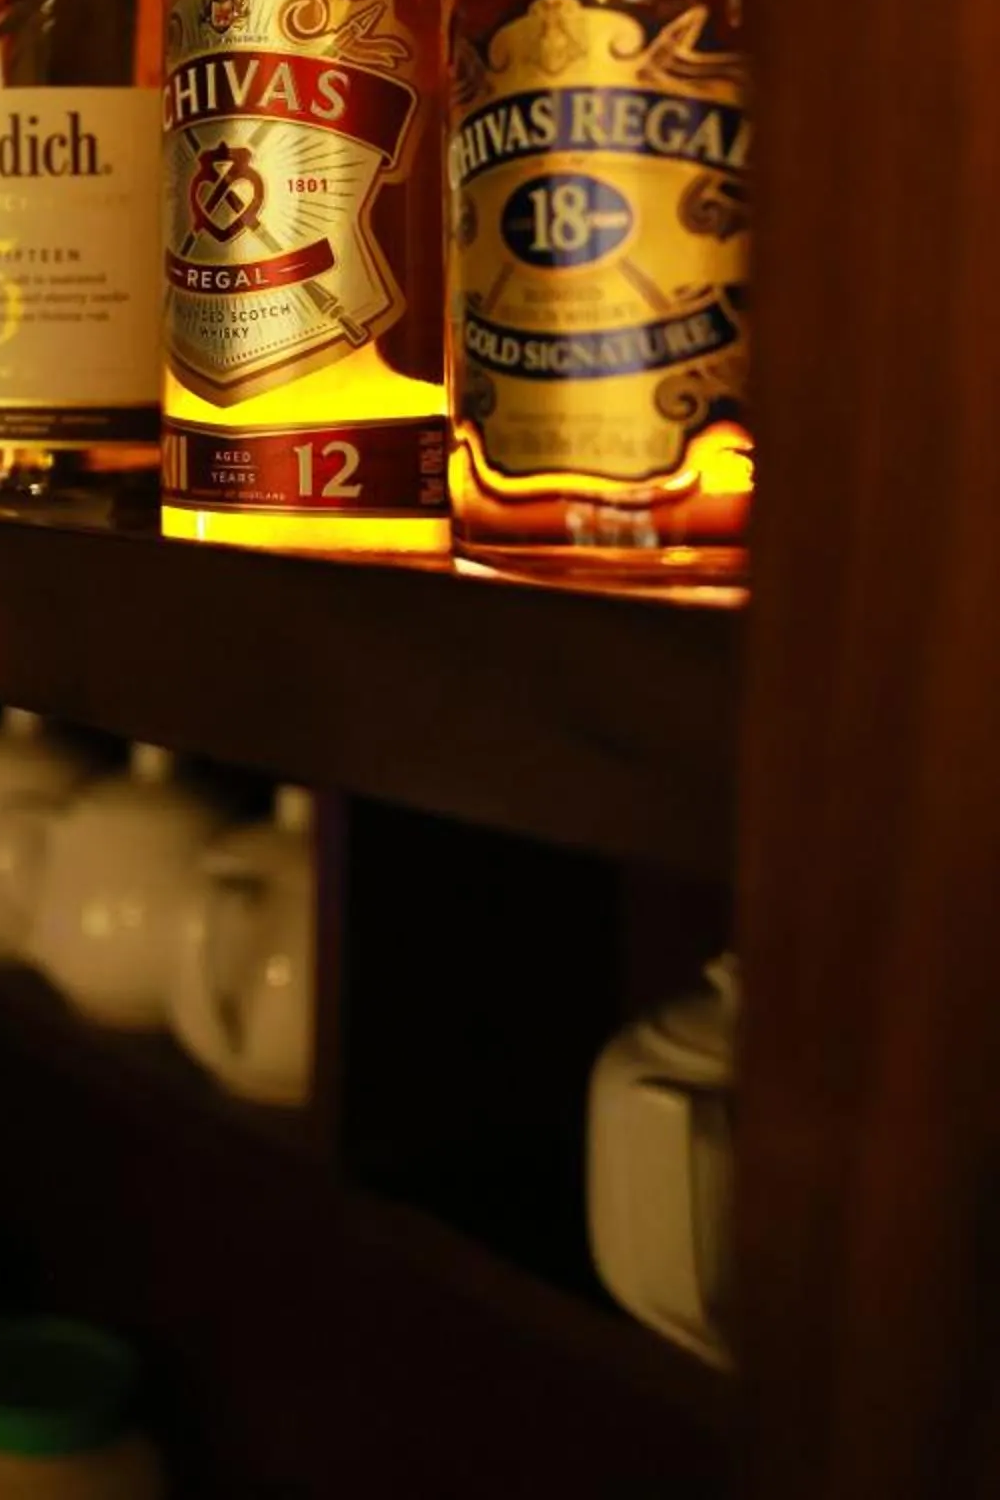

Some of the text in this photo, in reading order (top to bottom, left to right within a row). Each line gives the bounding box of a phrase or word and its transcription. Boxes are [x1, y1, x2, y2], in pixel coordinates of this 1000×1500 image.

[163, 58, 349, 132] CHIVAS
[287, 178, 328, 193] 1801
[528, 184, 590, 250] 18
[187, 267, 269, 290] REGAL
[231, 303, 291, 323] SCOTCH
[215, 450, 252, 463] AGED
[293, 440, 364, 498] 12
